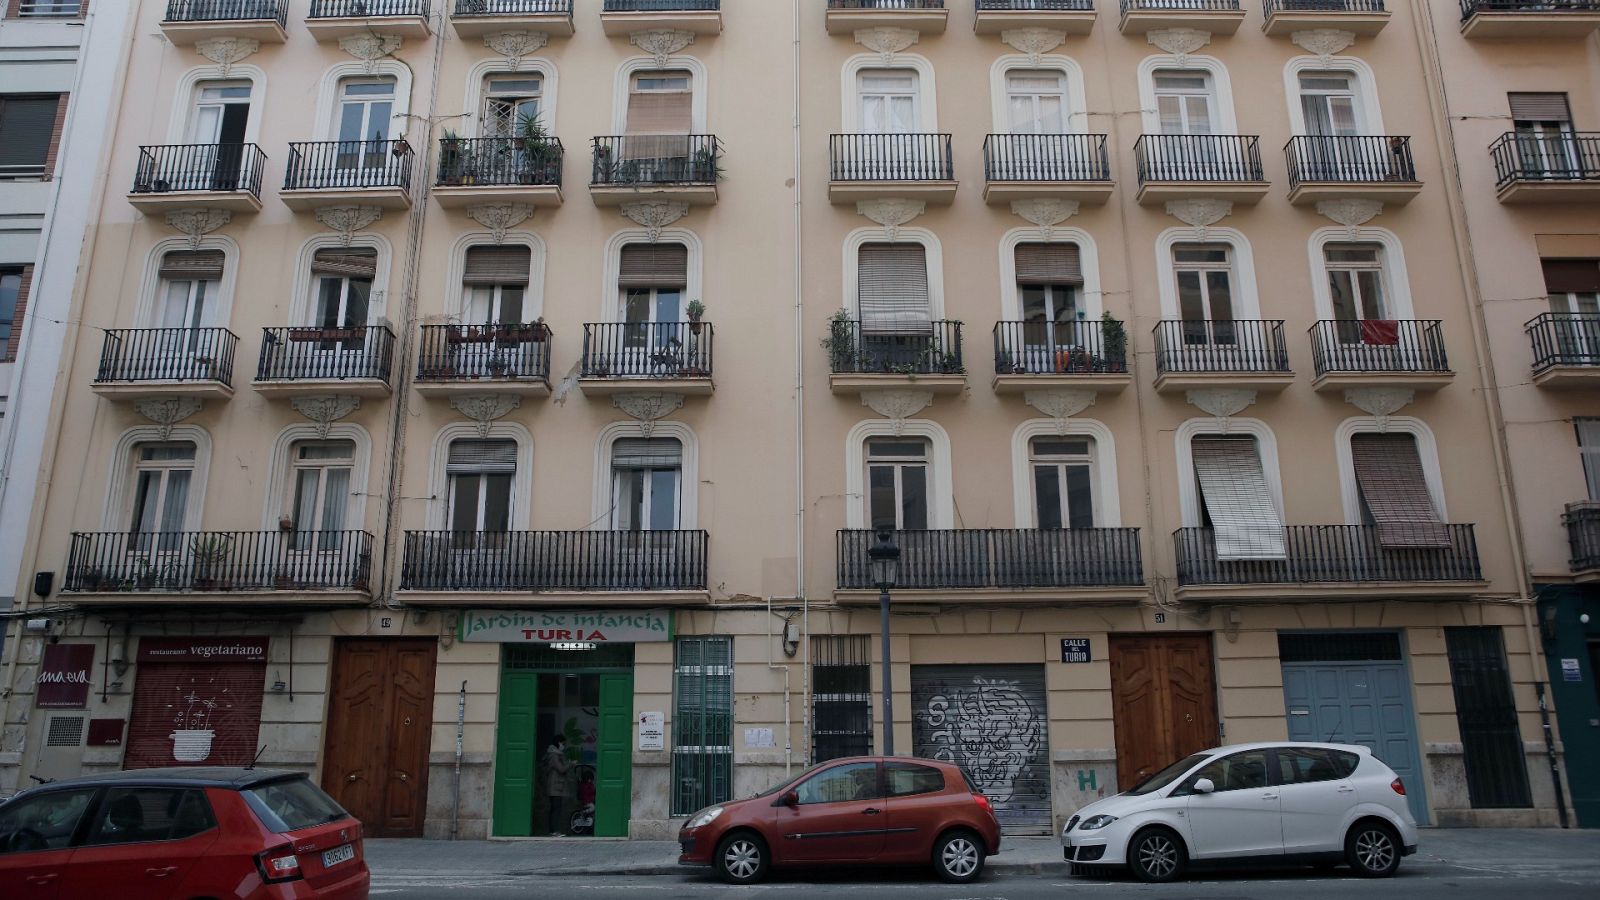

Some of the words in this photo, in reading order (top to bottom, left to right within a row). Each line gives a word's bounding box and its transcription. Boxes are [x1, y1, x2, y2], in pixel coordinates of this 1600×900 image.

[382, 618, 391, 627] 49
[541, 613, 566, 626] de
[574, 611, 665, 632] infancia
[1155, 614, 1164, 623] 51
[521, 629, 608, 641] TURIA
[1064, 639, 1087, 647] CALLE
[191, 644, 262, 658] vegetariano
[1064, 652, 1087, 662] TURIA
[1077, 769, 1097, 791] H
